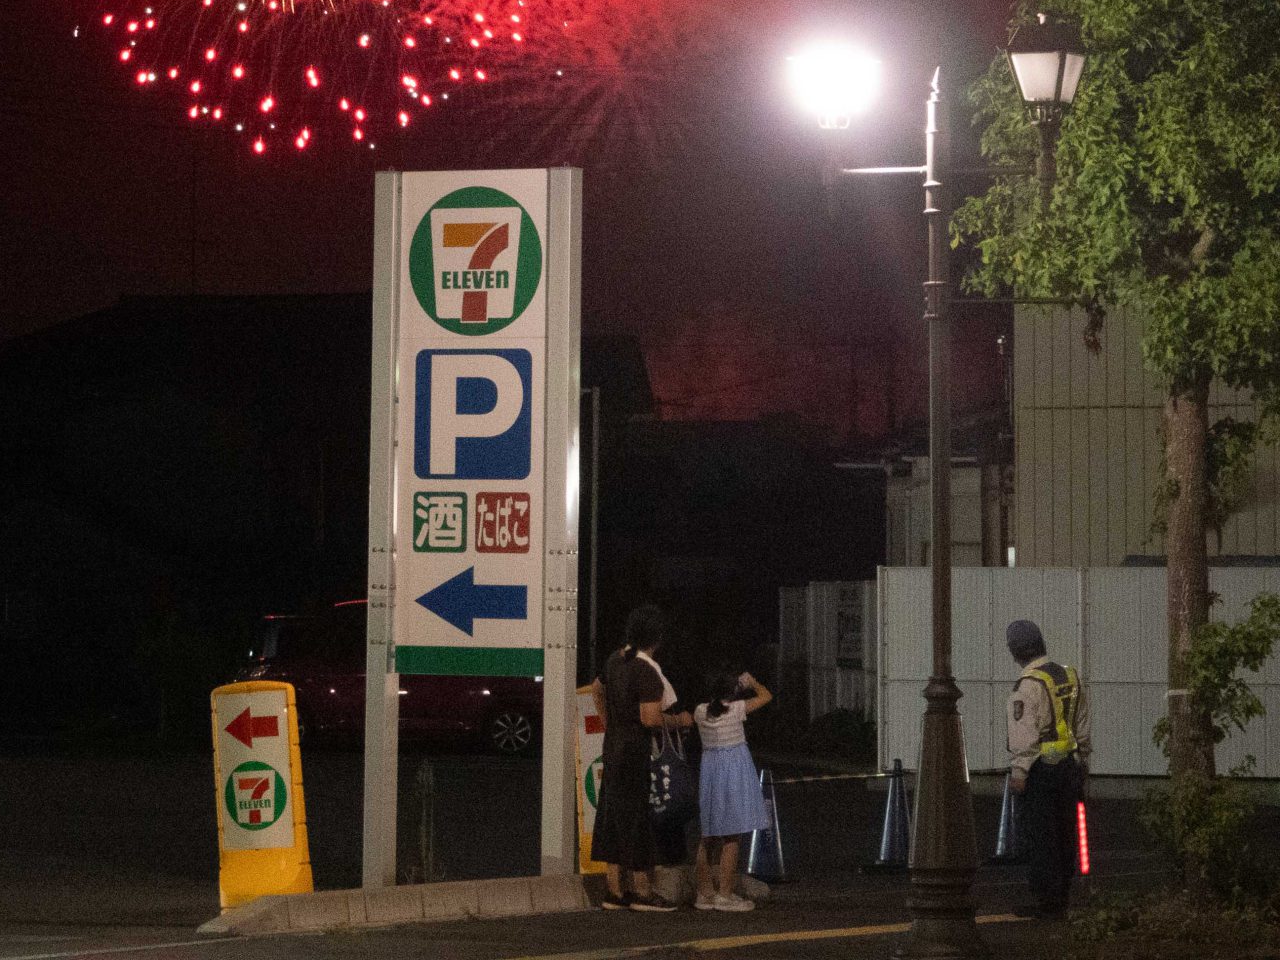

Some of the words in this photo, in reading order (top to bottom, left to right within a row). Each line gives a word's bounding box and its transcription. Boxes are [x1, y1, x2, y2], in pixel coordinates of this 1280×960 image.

[443, 222, 509, 322] 7
[429, 354, 524, 475] P
[416, 495, 463, 548] 酒
[476, 496, 529, 548] たばこ
[238, 776, 269, 824] 7
